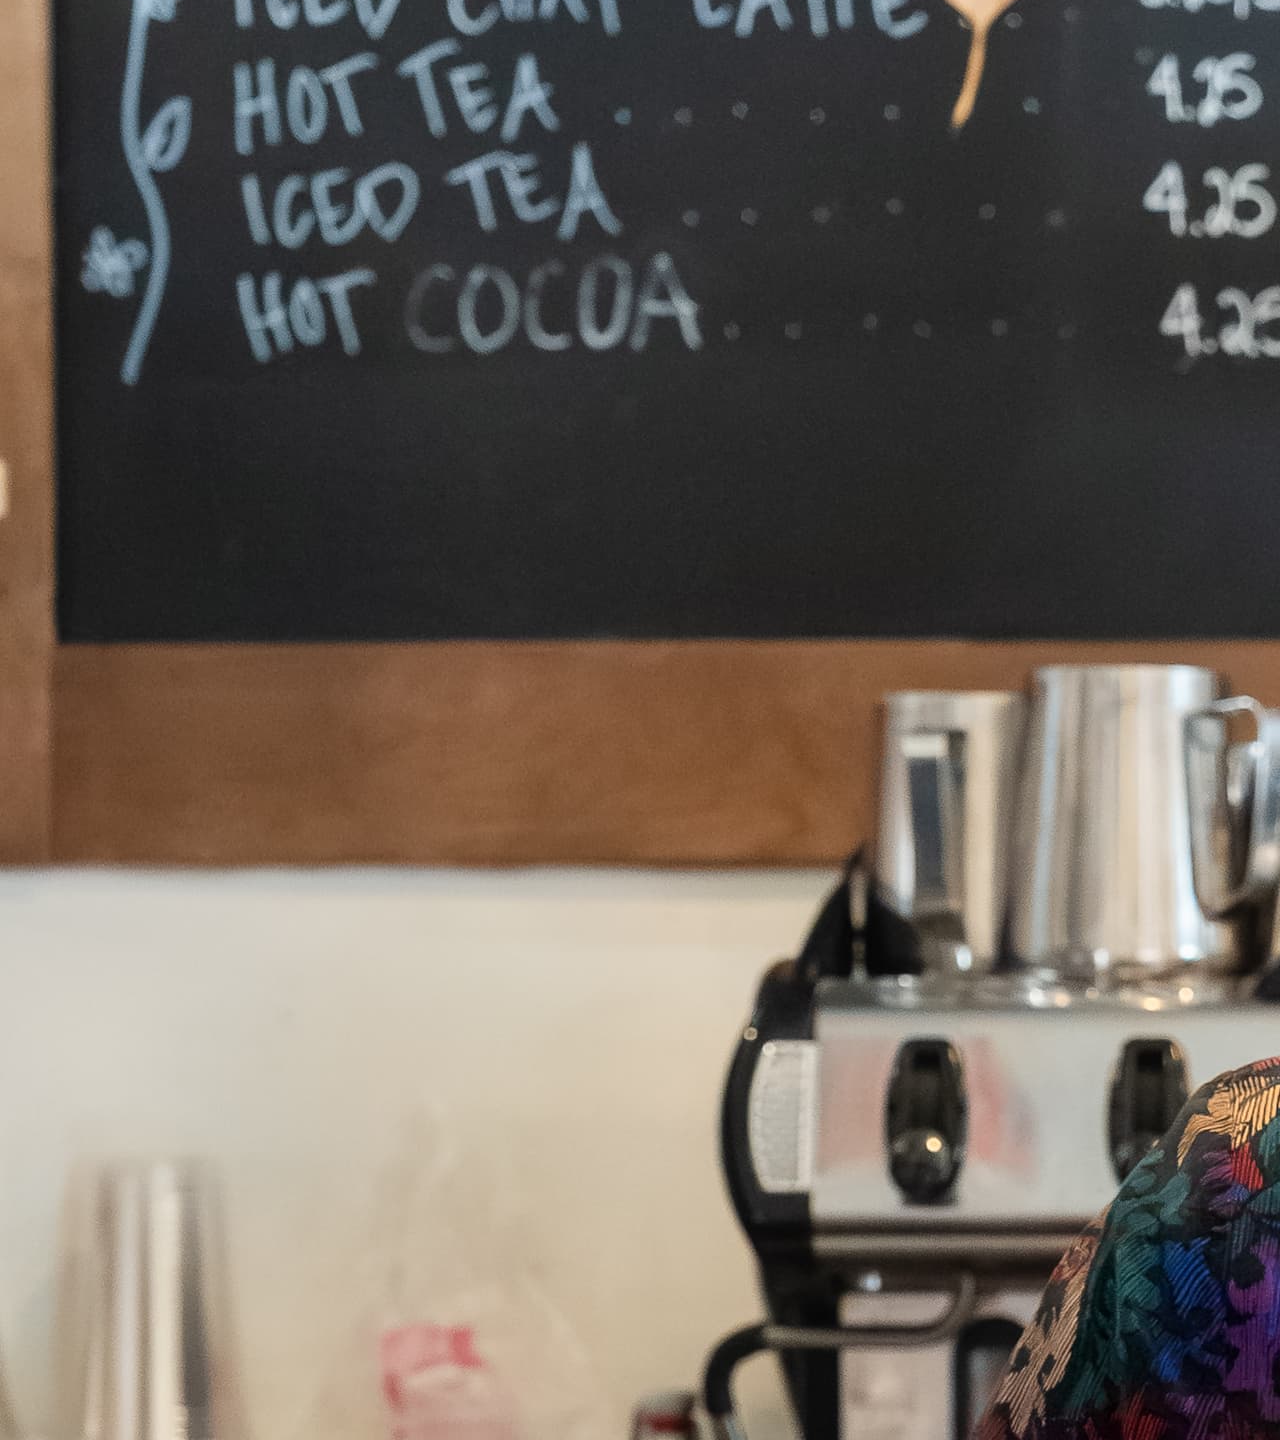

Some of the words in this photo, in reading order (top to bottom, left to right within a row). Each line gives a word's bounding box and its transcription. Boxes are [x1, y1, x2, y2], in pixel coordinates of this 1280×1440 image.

[233, 50, 379, 156] HOT
[399, 38, 560, 142] TEA
[241, 162, 420, 249] ICED
[447, 141, 624, 242] TEA
[1143, 160, 1278, 240] 4.25
[236, 268, 376, 362] HOT
[406, 251, 704, 354] COCOA
